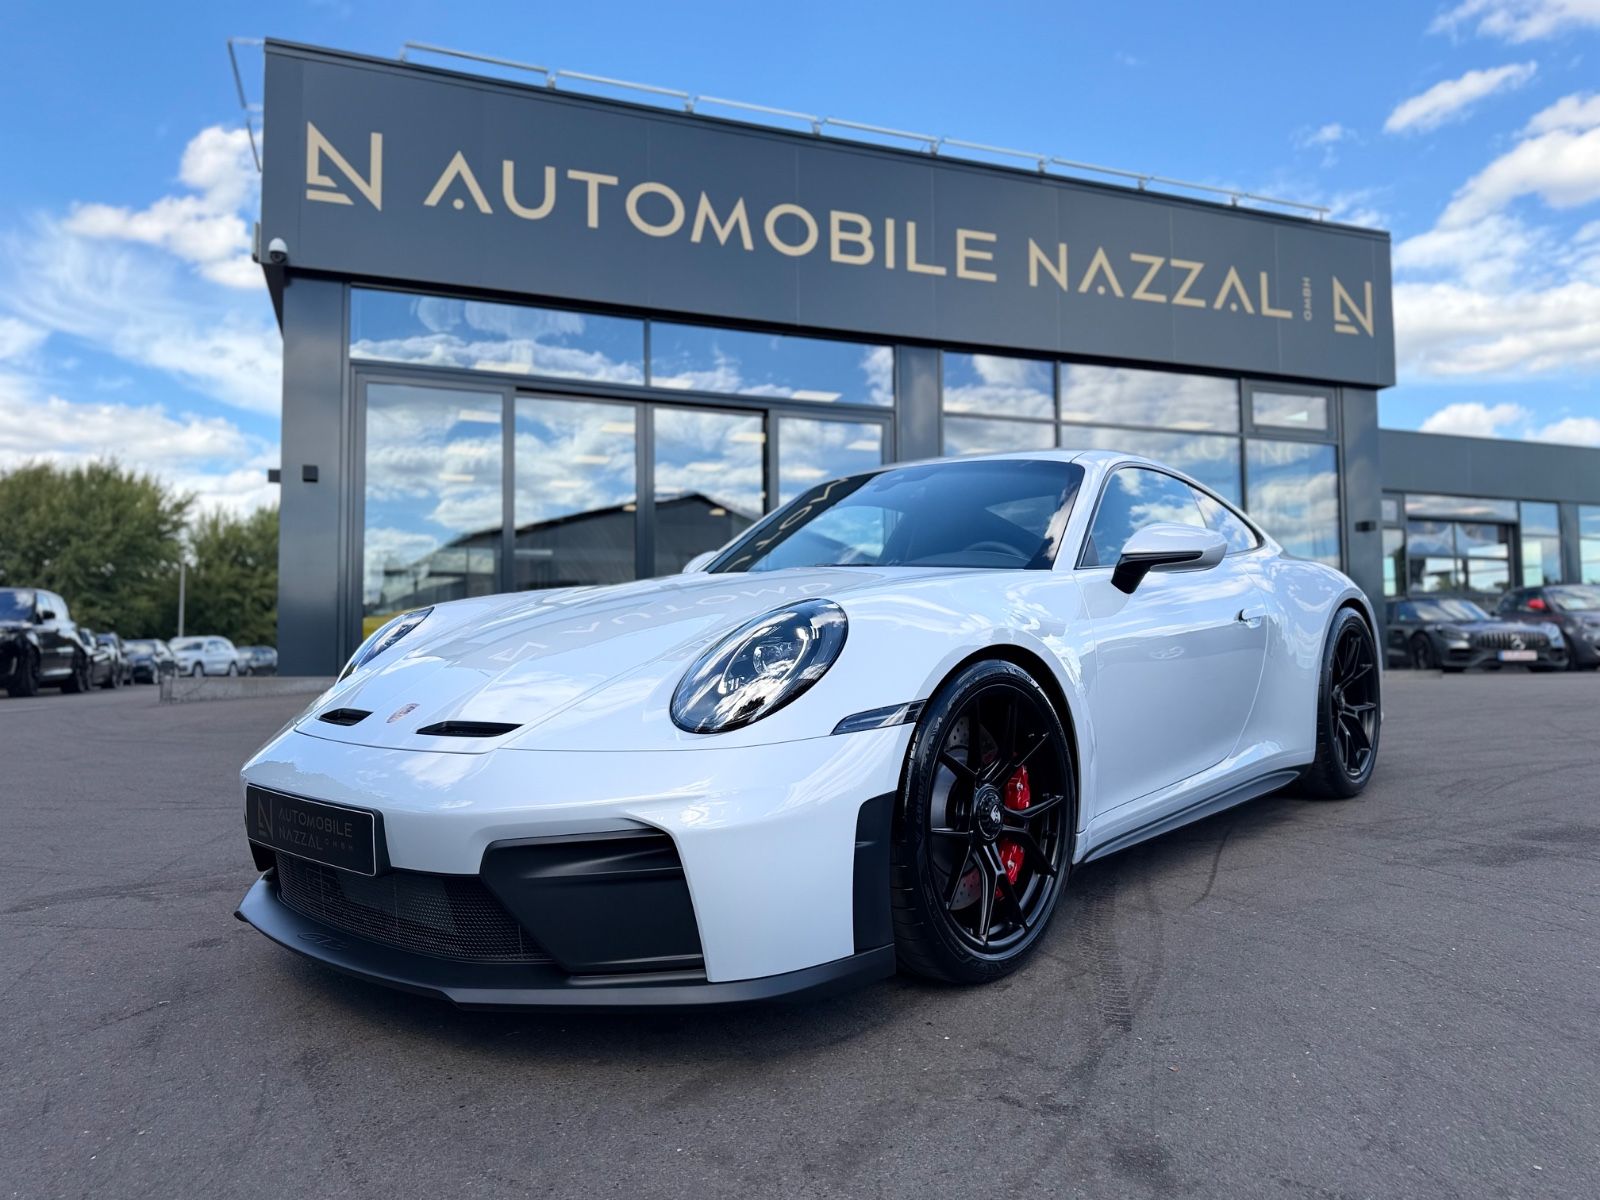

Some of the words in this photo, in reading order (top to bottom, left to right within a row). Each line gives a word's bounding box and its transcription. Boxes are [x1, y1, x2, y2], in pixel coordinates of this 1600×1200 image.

[424, 150, 997, 283] AUTOMOBILE
[1029, 238, 1292, 319] NAZZAL
[278, 807, 353, 838] AUTOMOBILE
[278, 826, 323, 850] NAZZAL
